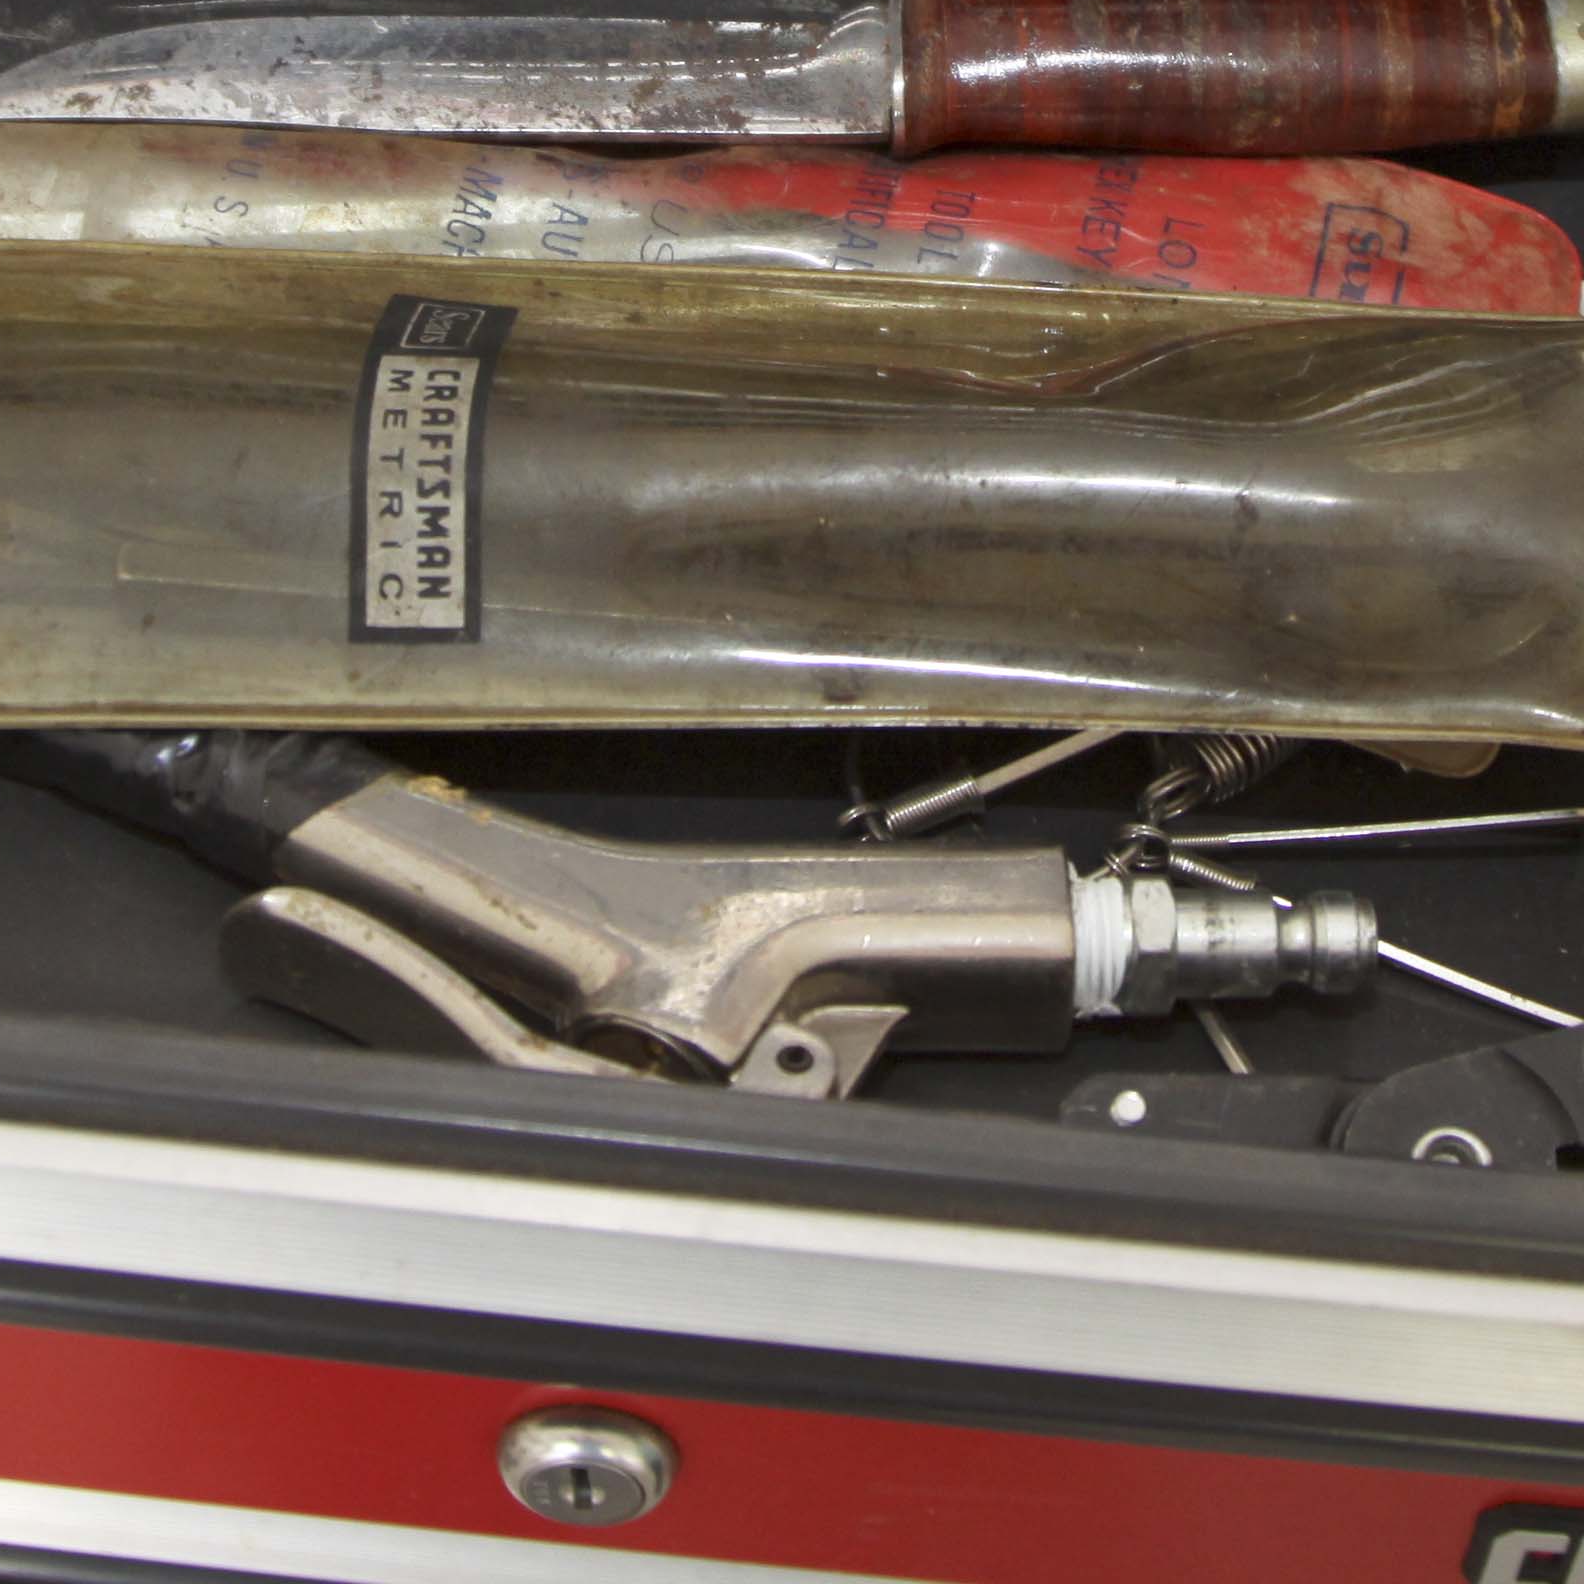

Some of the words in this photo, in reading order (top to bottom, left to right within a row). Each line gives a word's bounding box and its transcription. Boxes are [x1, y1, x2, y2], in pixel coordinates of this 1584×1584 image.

[917, 189, 978, 264] TOOL
[1076, 196, 1129, 267] KEY
[419, 309, 471, 344] Sears
[377, 368, 415, 601] METRIC
[416, 369, 462, 600] CRAFTSMAN
